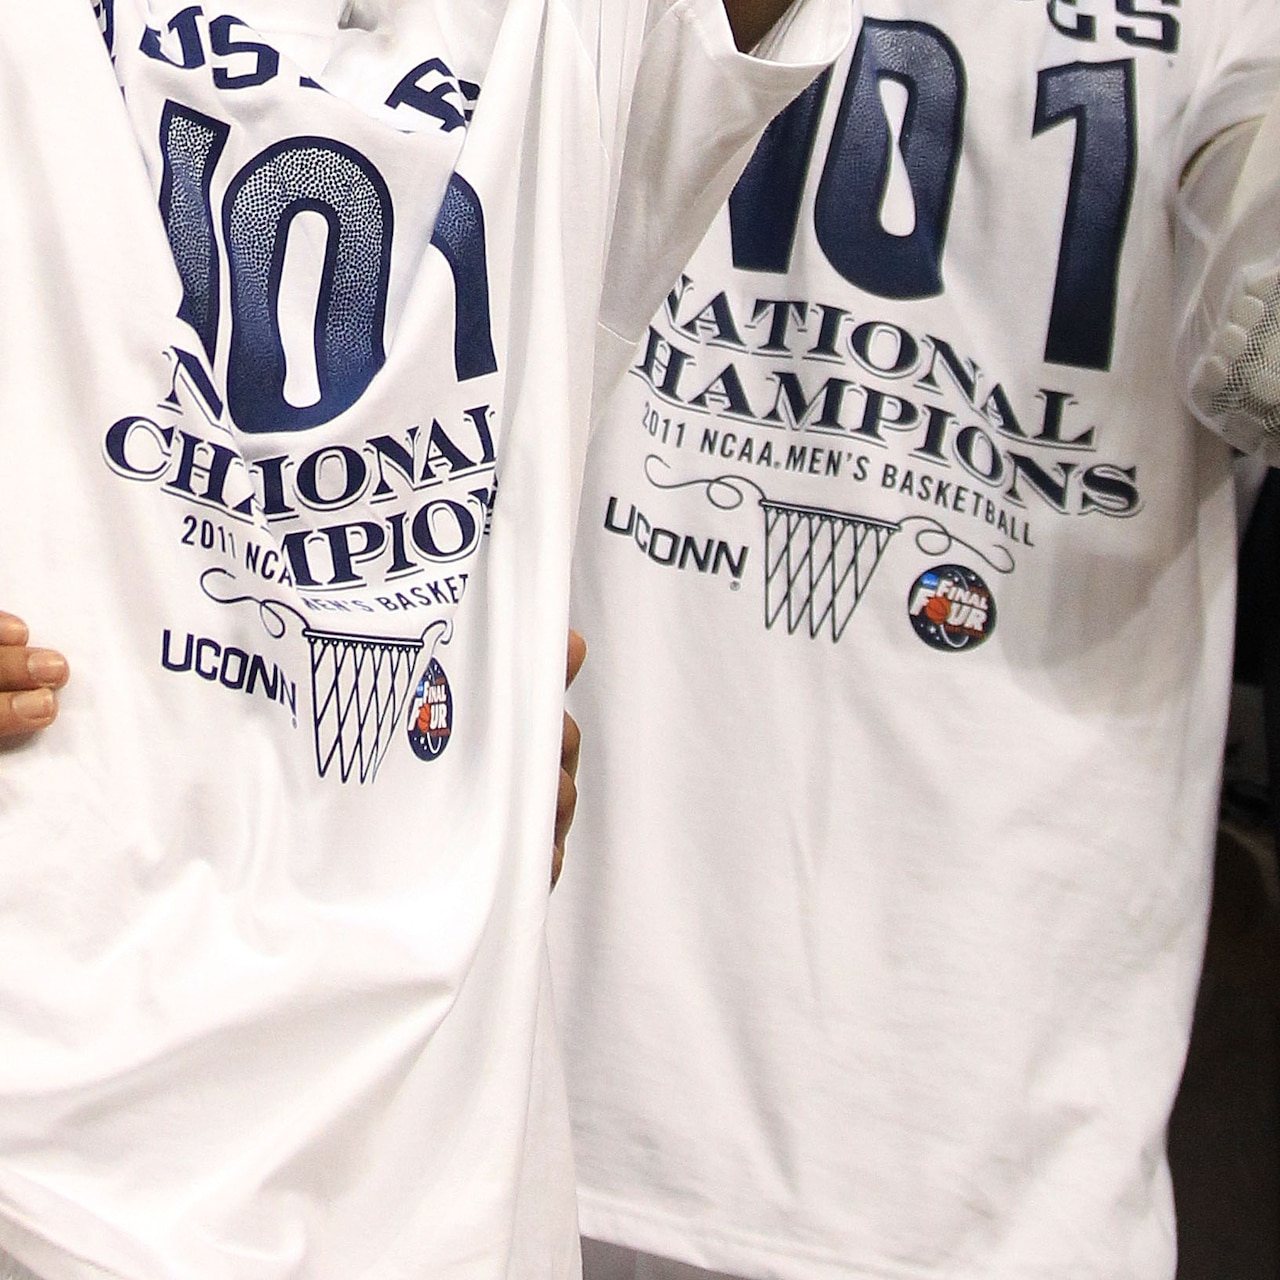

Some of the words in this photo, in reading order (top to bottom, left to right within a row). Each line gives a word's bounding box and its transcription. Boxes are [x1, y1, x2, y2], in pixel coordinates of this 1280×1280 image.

[642, 401, 686, 448] 2011
[785, 443, 872, 482] MEN'S
[881, 465, 1035, 547] BASKETBALL
[181, 515, 236, 559] 2011
[604, 496, 749, 579] UCONN
[936, 579, 989, 610] FINAL
[162, 630, 297, 718] UCONN
